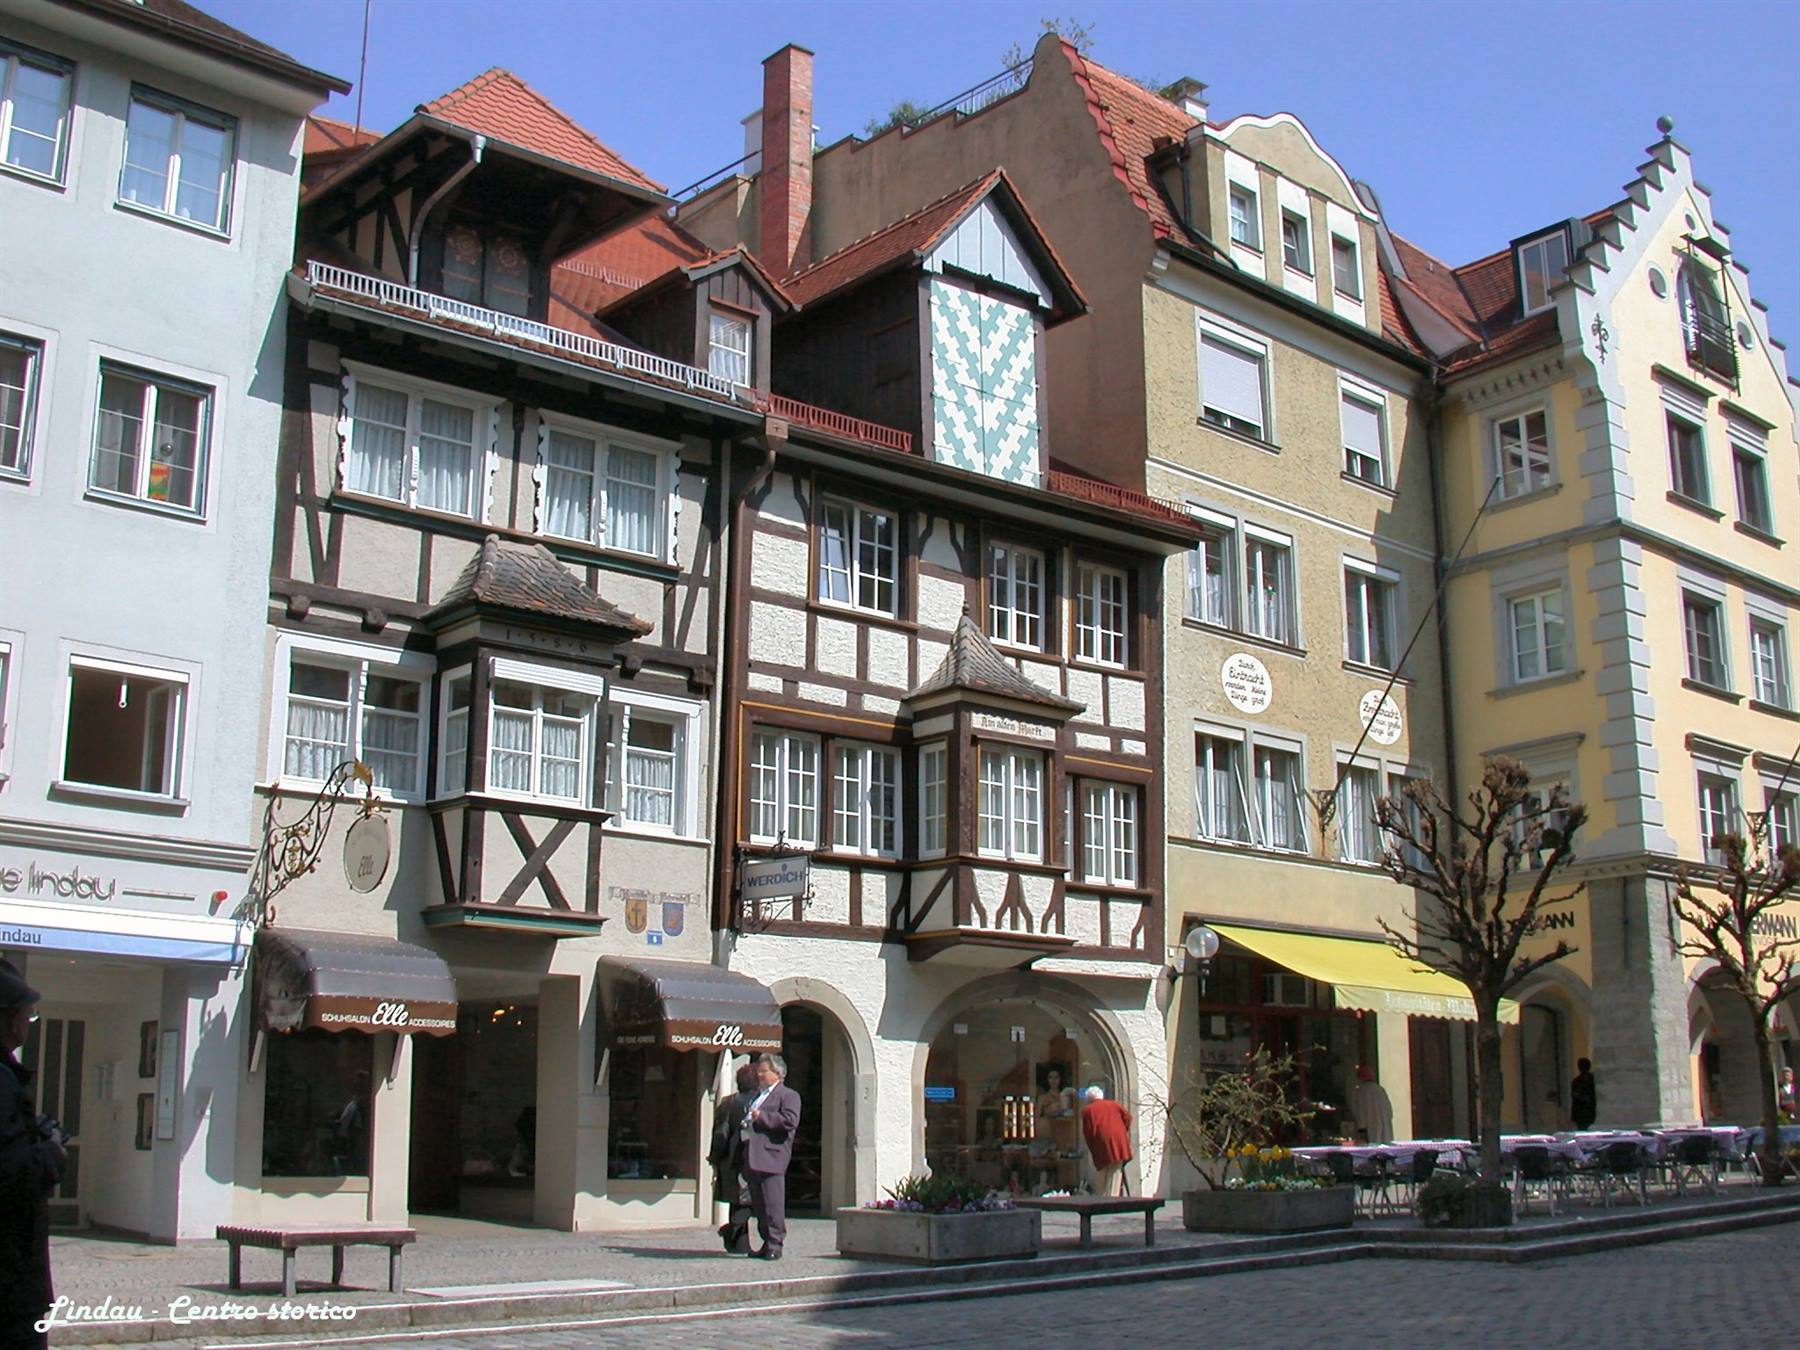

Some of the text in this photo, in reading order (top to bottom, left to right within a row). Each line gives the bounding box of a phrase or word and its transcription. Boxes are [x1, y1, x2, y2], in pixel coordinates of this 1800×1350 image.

[28, 860, 116, 902] lindau
[0, 929, 42, 944] ndau
[321, 1002, 456, 1029] SCHUHSALON Elle ACCESSOIRES
[712, 1024, 744, 1046] Elle
